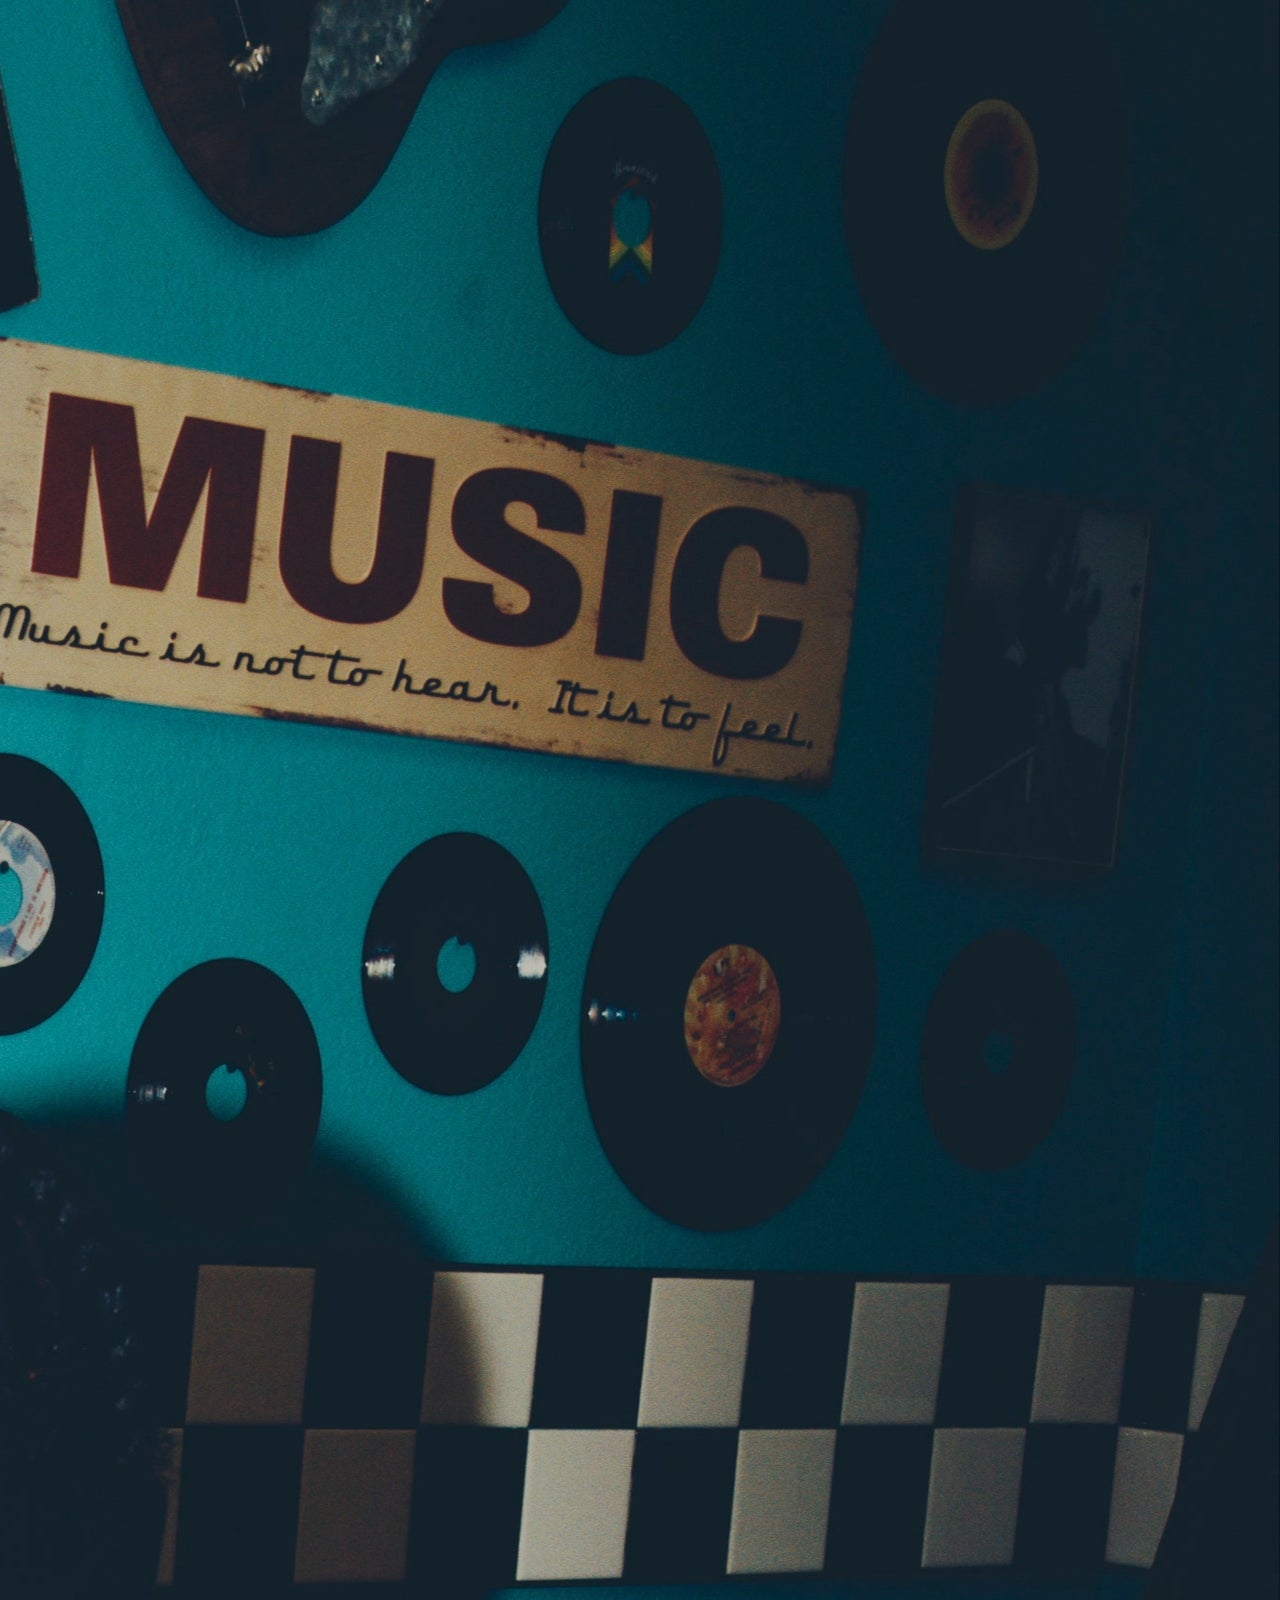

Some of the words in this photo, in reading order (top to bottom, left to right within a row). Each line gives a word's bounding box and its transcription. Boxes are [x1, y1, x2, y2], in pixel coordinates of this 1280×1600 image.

[31, 391, 809, 681] MUSIC
[159, 631, 221, 668] is
[233, 645, 324, 681] not
[326, 649, 383, 688] to
[392, 657, 520, 711] hear.
[548, 679, 599, 717] It
[597, 691, 651, 727] is
[659, 695, 711, 732] to
[712, 702, 814, 767] feel.
